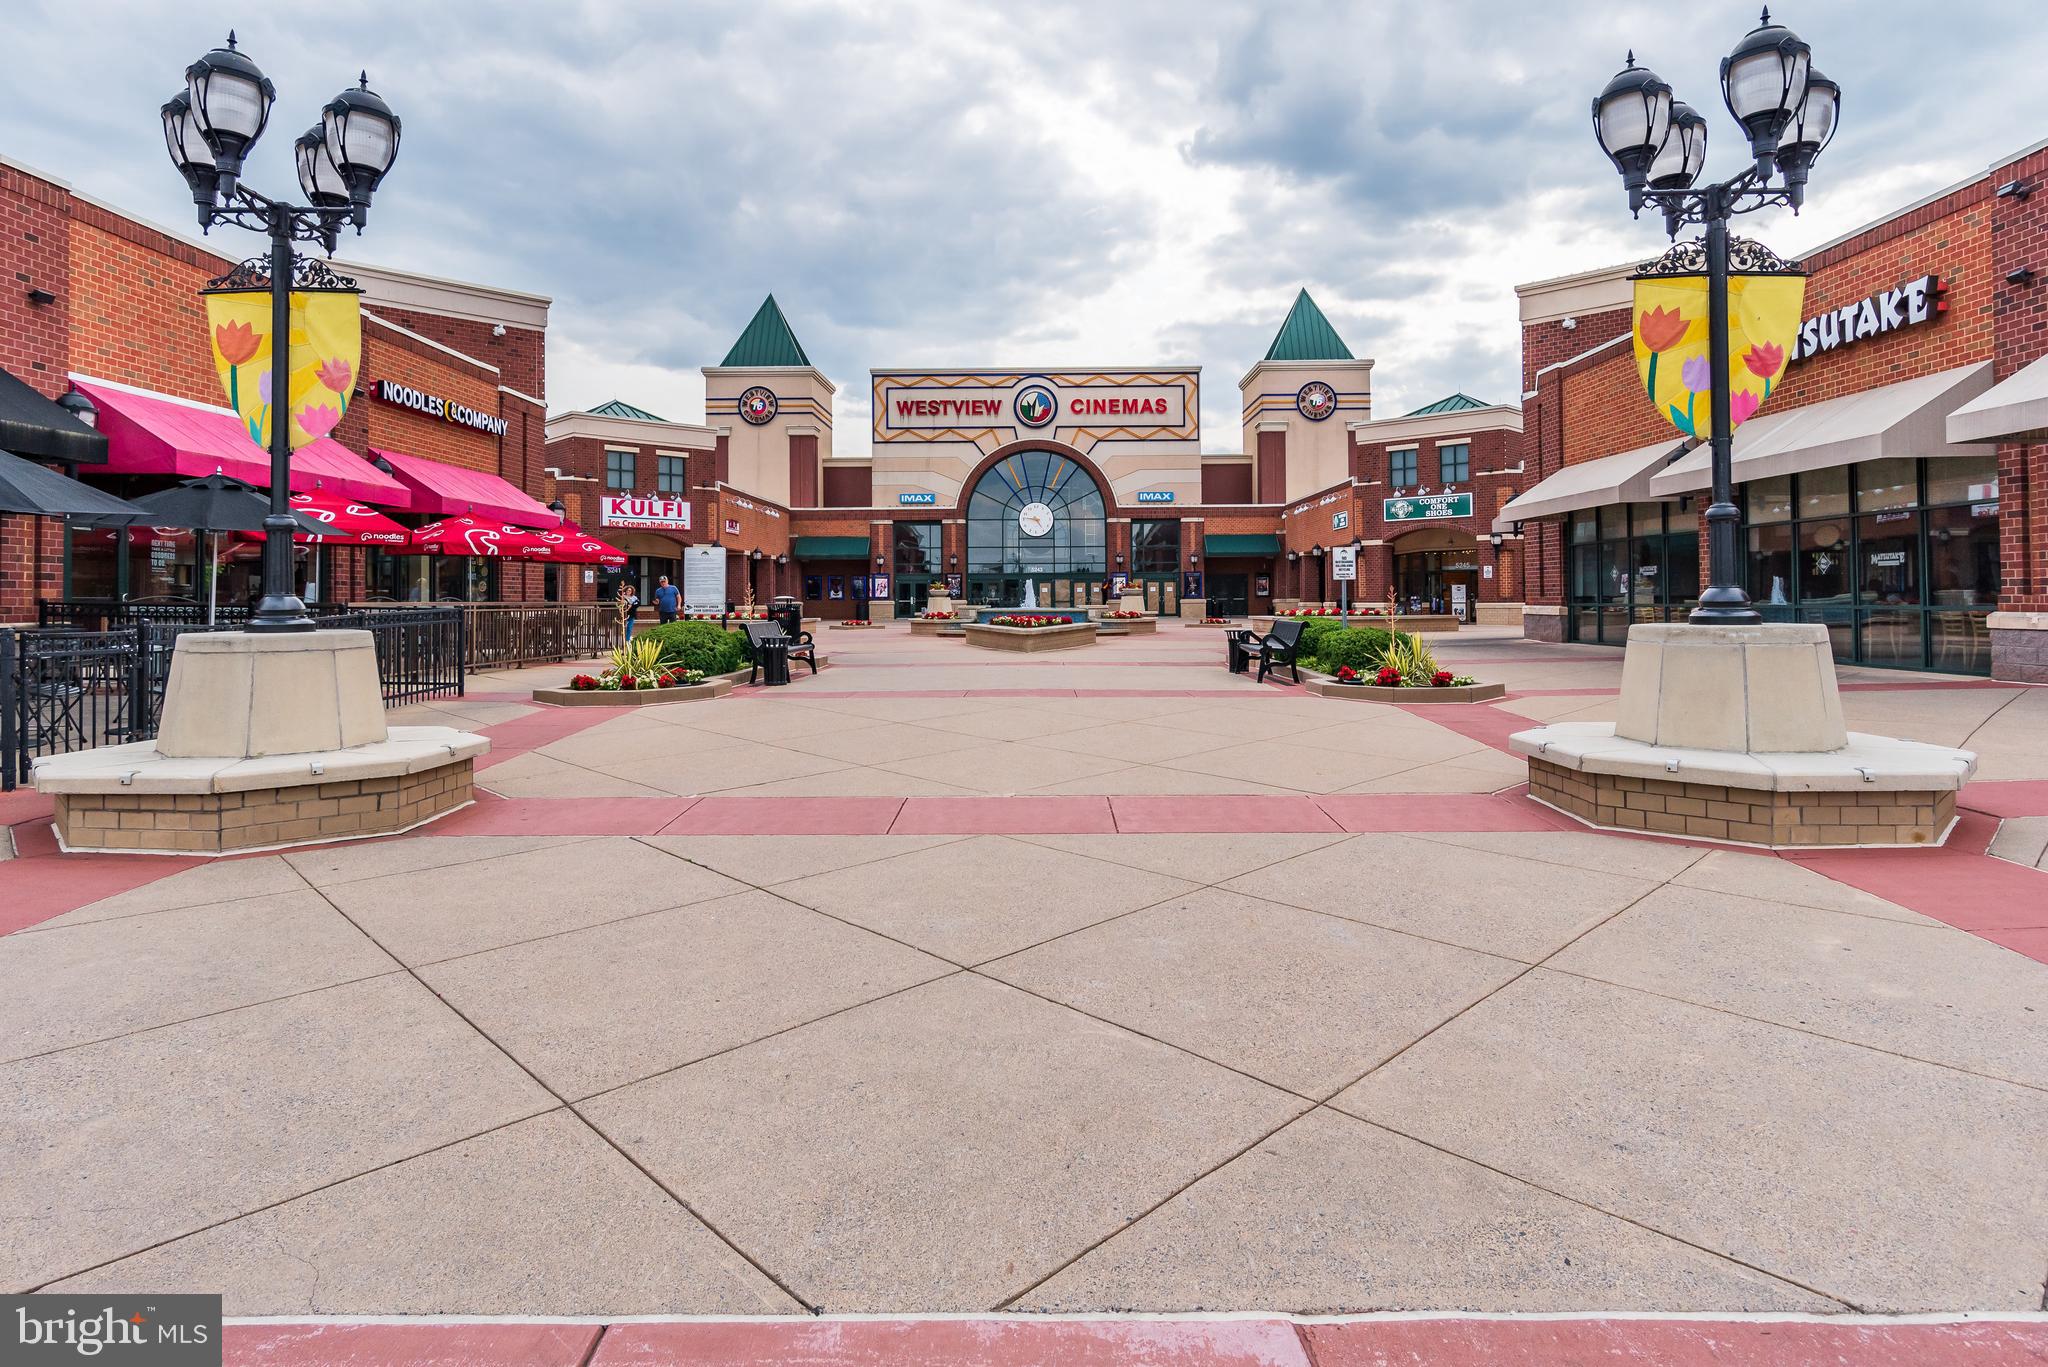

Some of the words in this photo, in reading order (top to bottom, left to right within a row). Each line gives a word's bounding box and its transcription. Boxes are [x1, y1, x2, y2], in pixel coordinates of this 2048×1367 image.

[742, 390, 774, 407] WESTVIEW
[1300, 385, 1333, 403] WESTVIEW
[383, 380, 444, 417] NOODLES
[458, 404, 508, 436] COMPANY
[896, 400, 1002, 416] WESTVIEW
[1070, 399, 1168, 415] CINEMAS
[1301, 405, 1332, 418] CINEMAS
[743, 410, 773, 422] CINEMAS
[901, 494, 932, 503] IMAX
[1139, 492, 1171, 501] IMAX
[1419, 496, 1459, 505] COMFORT
[611, 499, 682, 518] KULFI
[1425, 509, 1453, 517] SHOES
[608, 519, 620, 527] Ice
